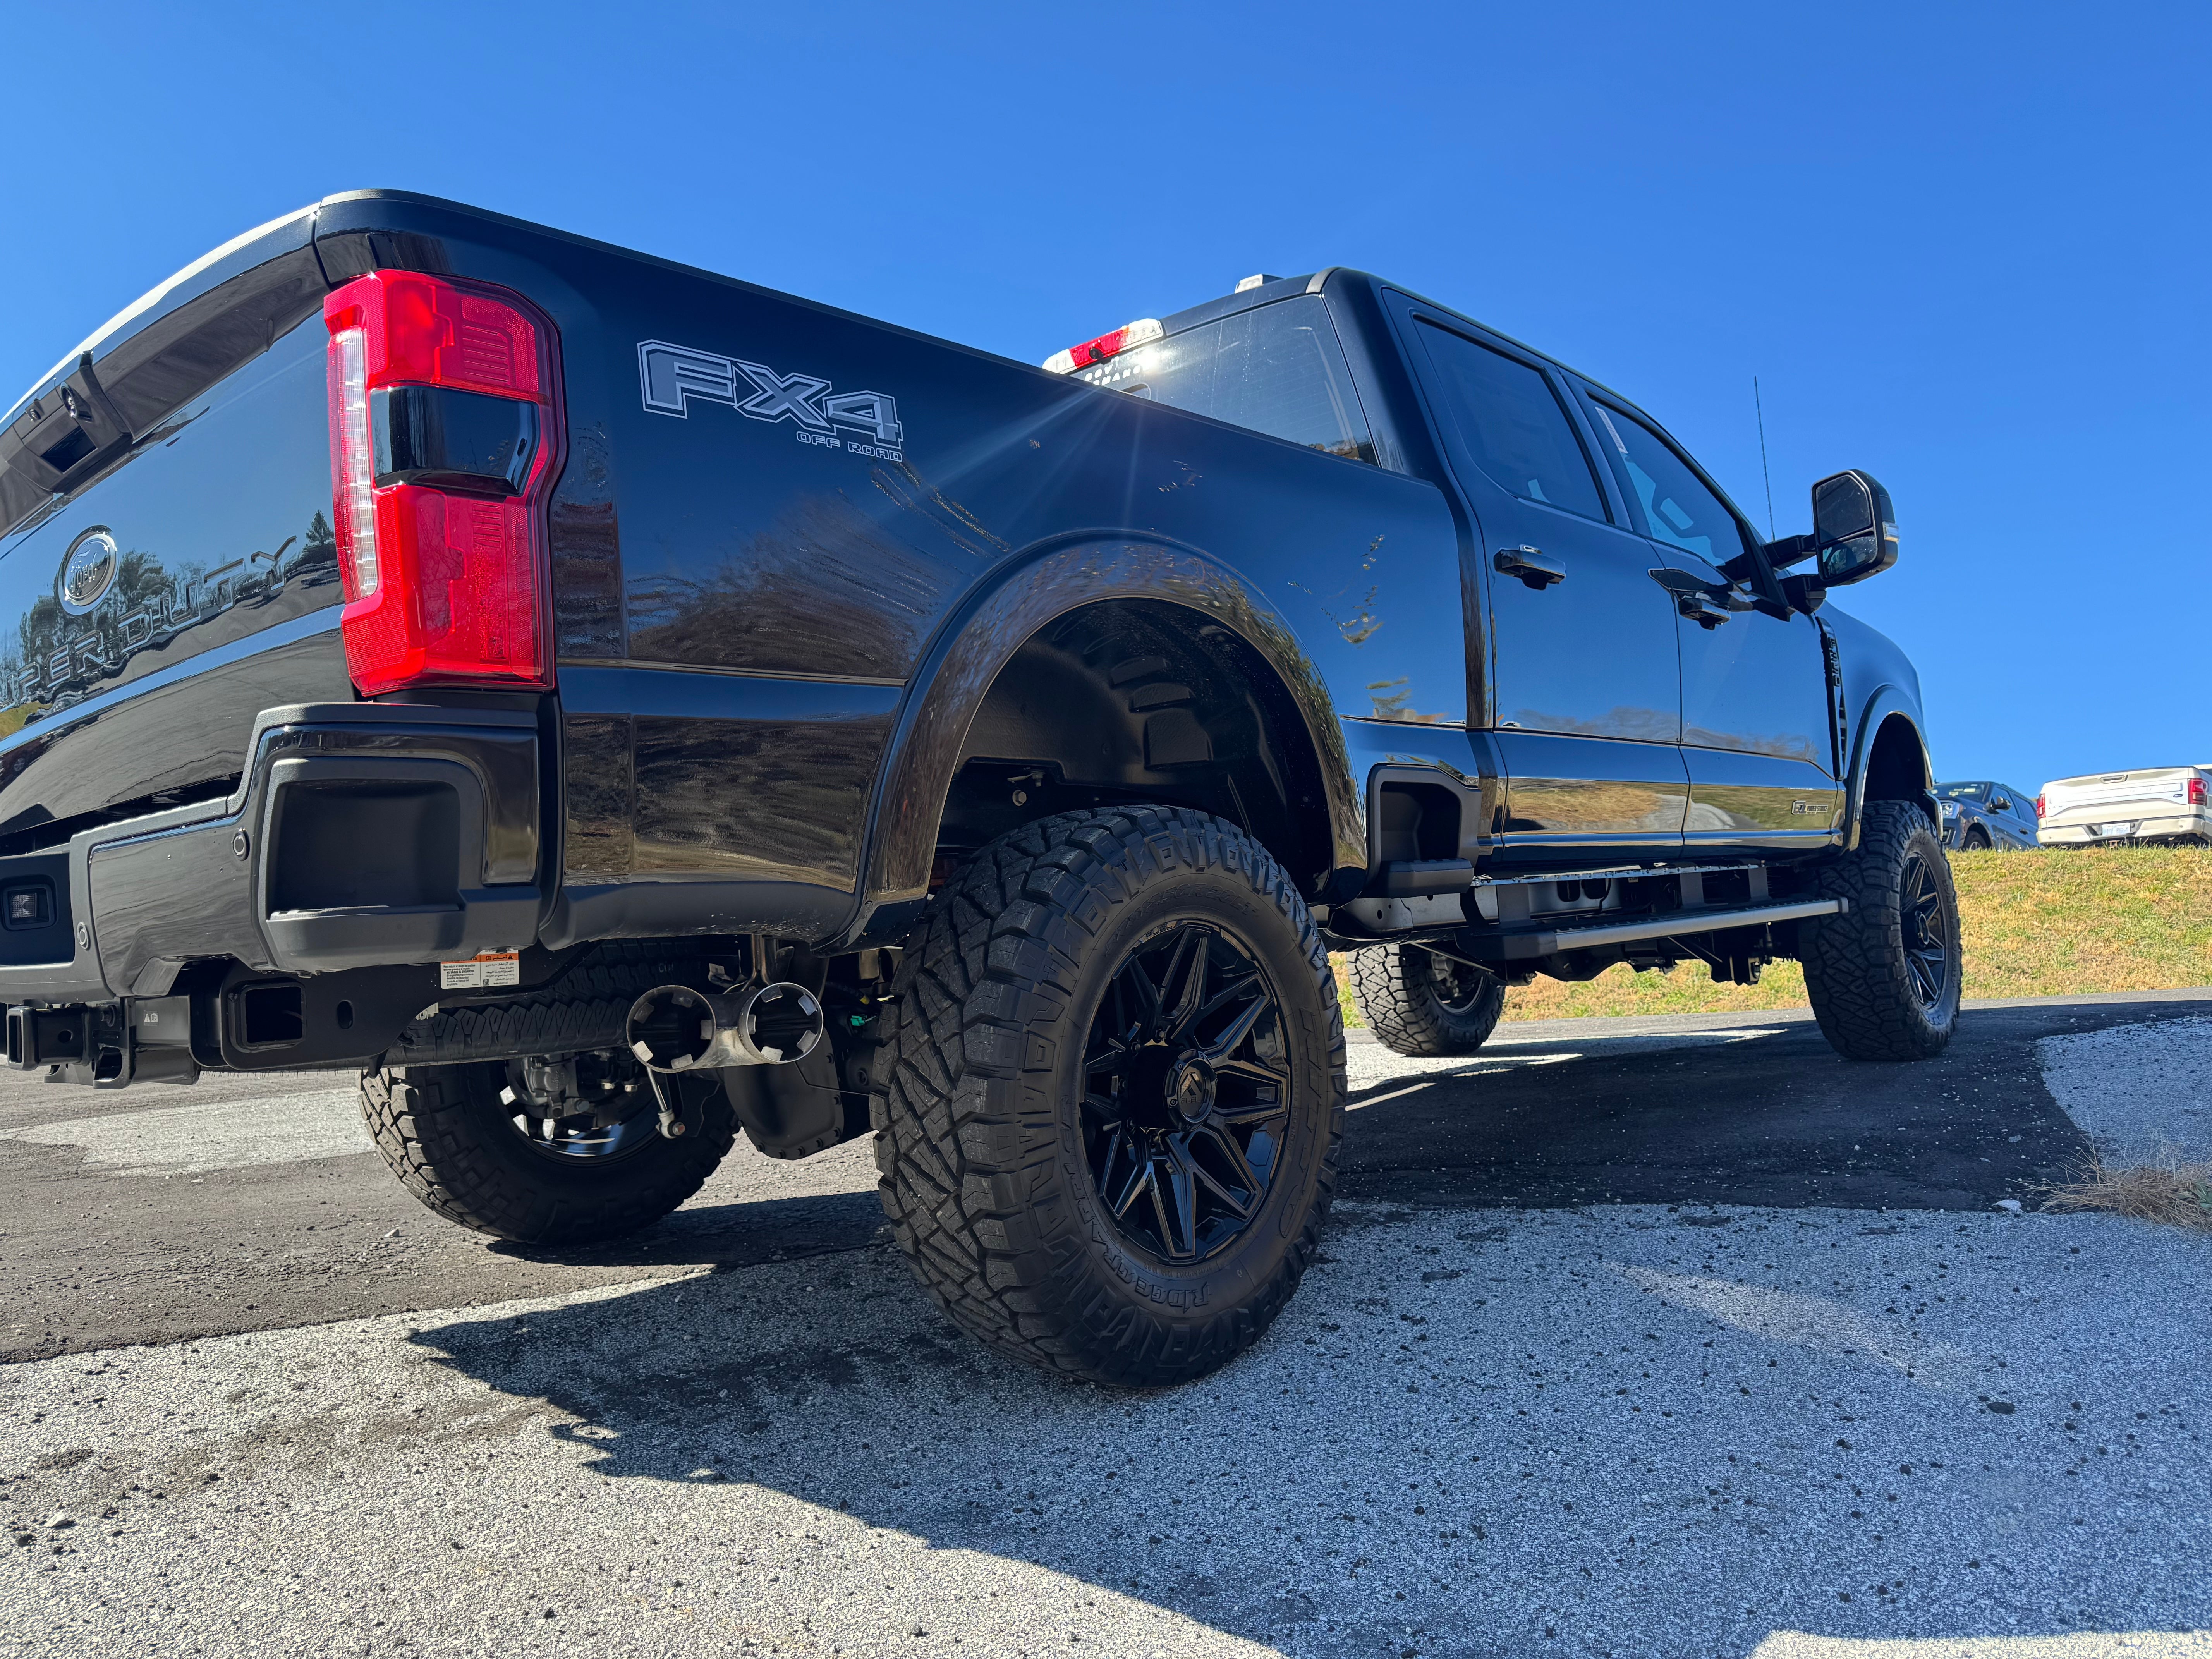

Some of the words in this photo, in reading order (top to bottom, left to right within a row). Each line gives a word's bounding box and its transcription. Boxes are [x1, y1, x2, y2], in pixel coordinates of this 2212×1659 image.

[637, 339, 903, 449] FX4
[796, 431, 840, 448] OFF
[847, 441, 903, 462] ROAD
[118, 536, 297, 654] DUTY
[1146, 924, 1174, 940] FUEL
[1135, 1277, 1213, 1313] RIDGE
